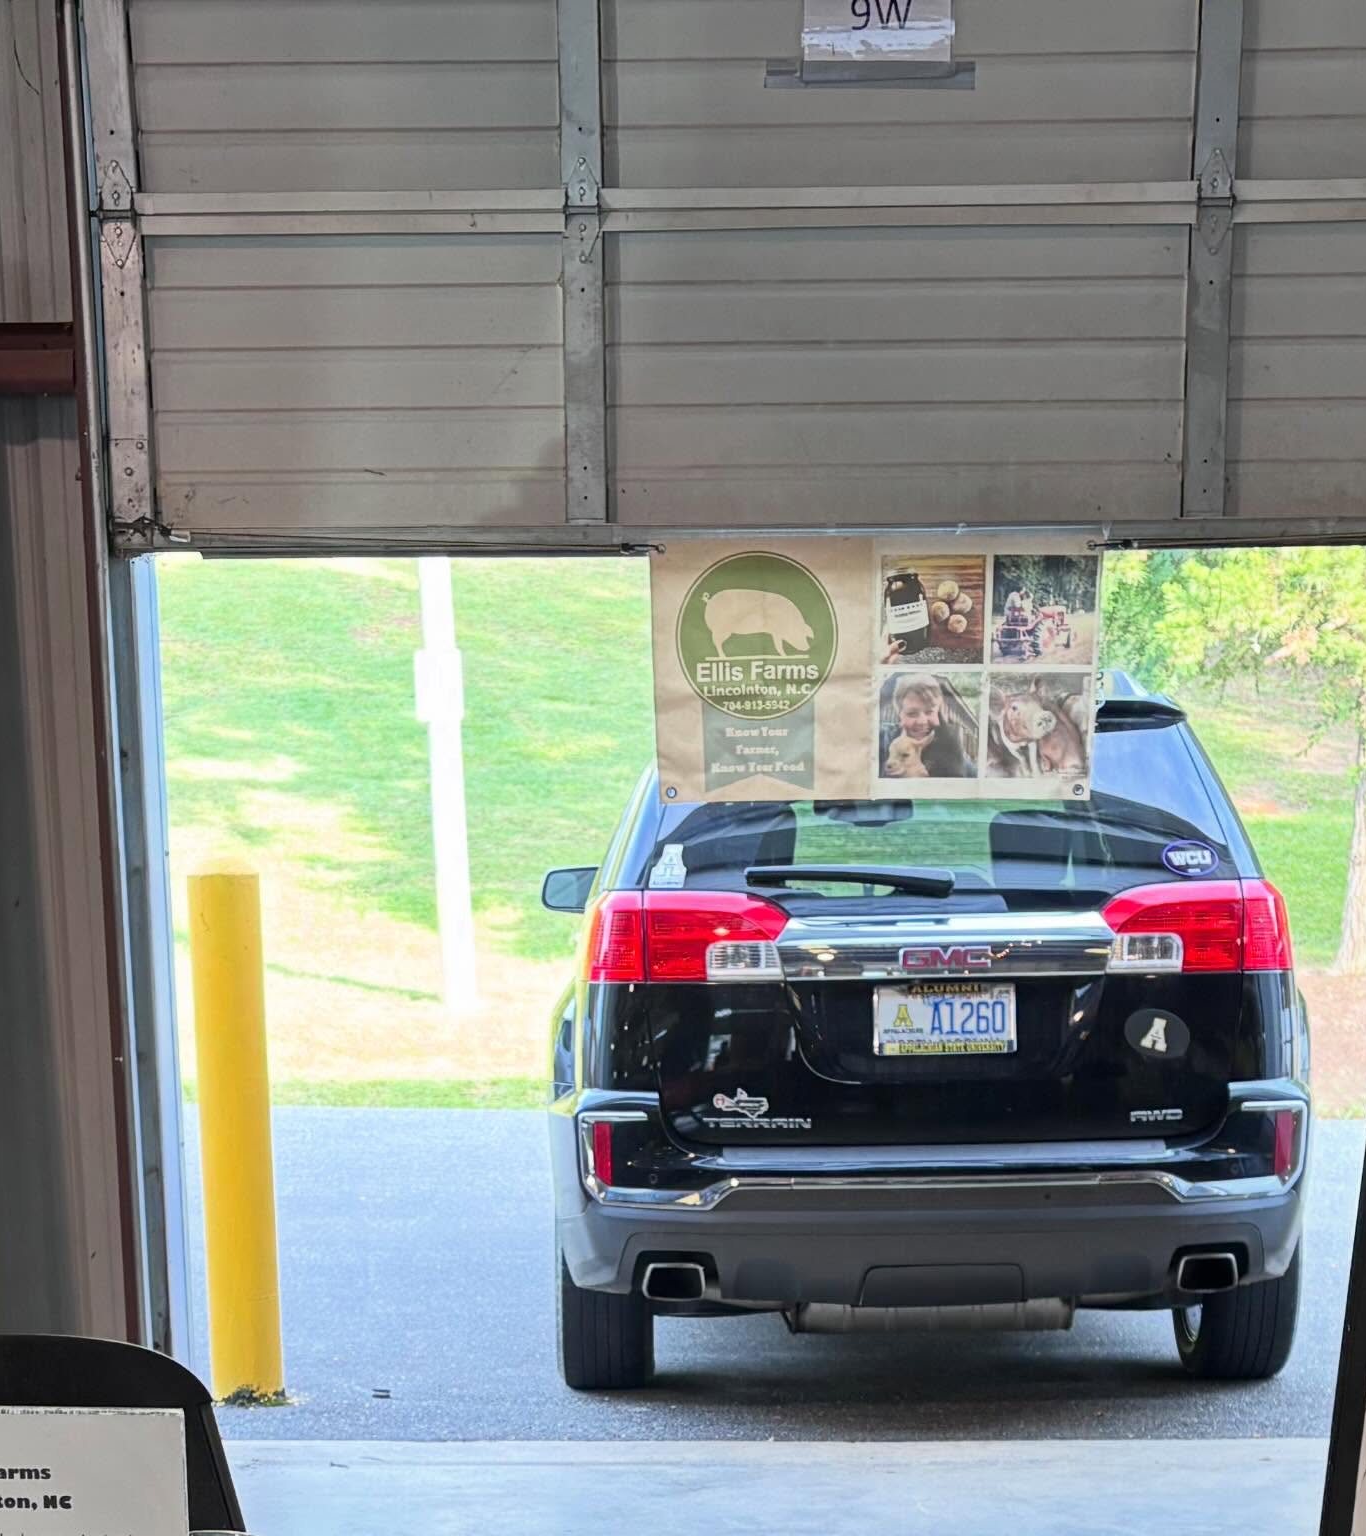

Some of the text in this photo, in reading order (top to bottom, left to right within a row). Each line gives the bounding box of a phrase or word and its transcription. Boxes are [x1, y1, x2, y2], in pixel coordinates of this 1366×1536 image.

[850, 0, 912, 31] 9W
[696, 660, 819, 682] Ellis Farms
[703, 684, 782, 697] Lincolnton,
[1167, 850, 1212, 866] WCU
[899, 946, 992, 970] GMC
[931, 1000, 1006, 1035] A1260
[1130, 1108, 1183, 1122] AWD
[43, 1495, 73, 1510] NC
